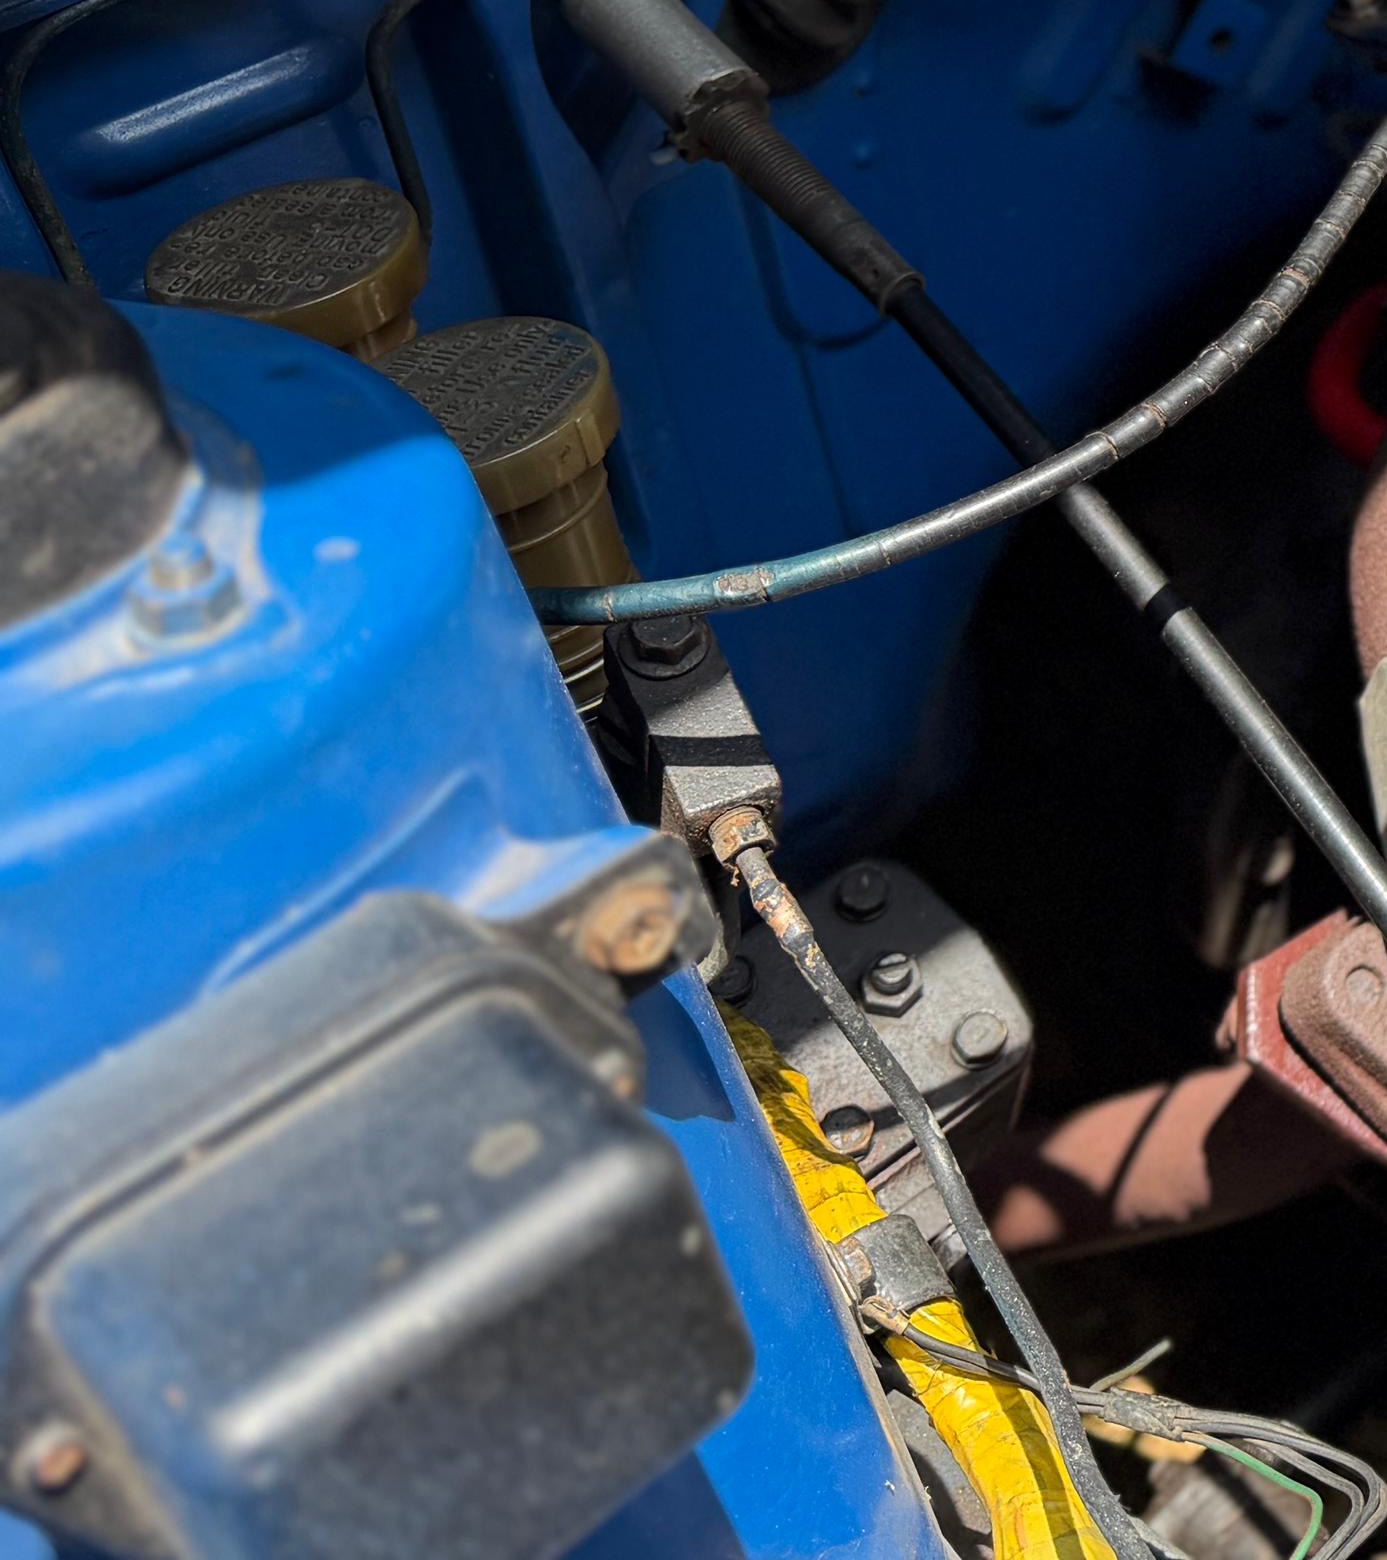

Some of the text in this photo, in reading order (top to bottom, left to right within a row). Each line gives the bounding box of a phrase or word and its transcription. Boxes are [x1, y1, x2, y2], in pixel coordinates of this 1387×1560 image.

[341, 203, 397, 222] from
[191, 223, 234, 239] only
[242, 231, 285, 248] Use
[223, 246, 306, 263] before
[318, 255, 364, 270] cap
[170, 259, 328, 289] Clean filler
[167, 277, 287, 305] WARNING
[504, 324, 546, 355] only
[419, 330, 475, 373] filler
[504, 370, 590, 443] container
